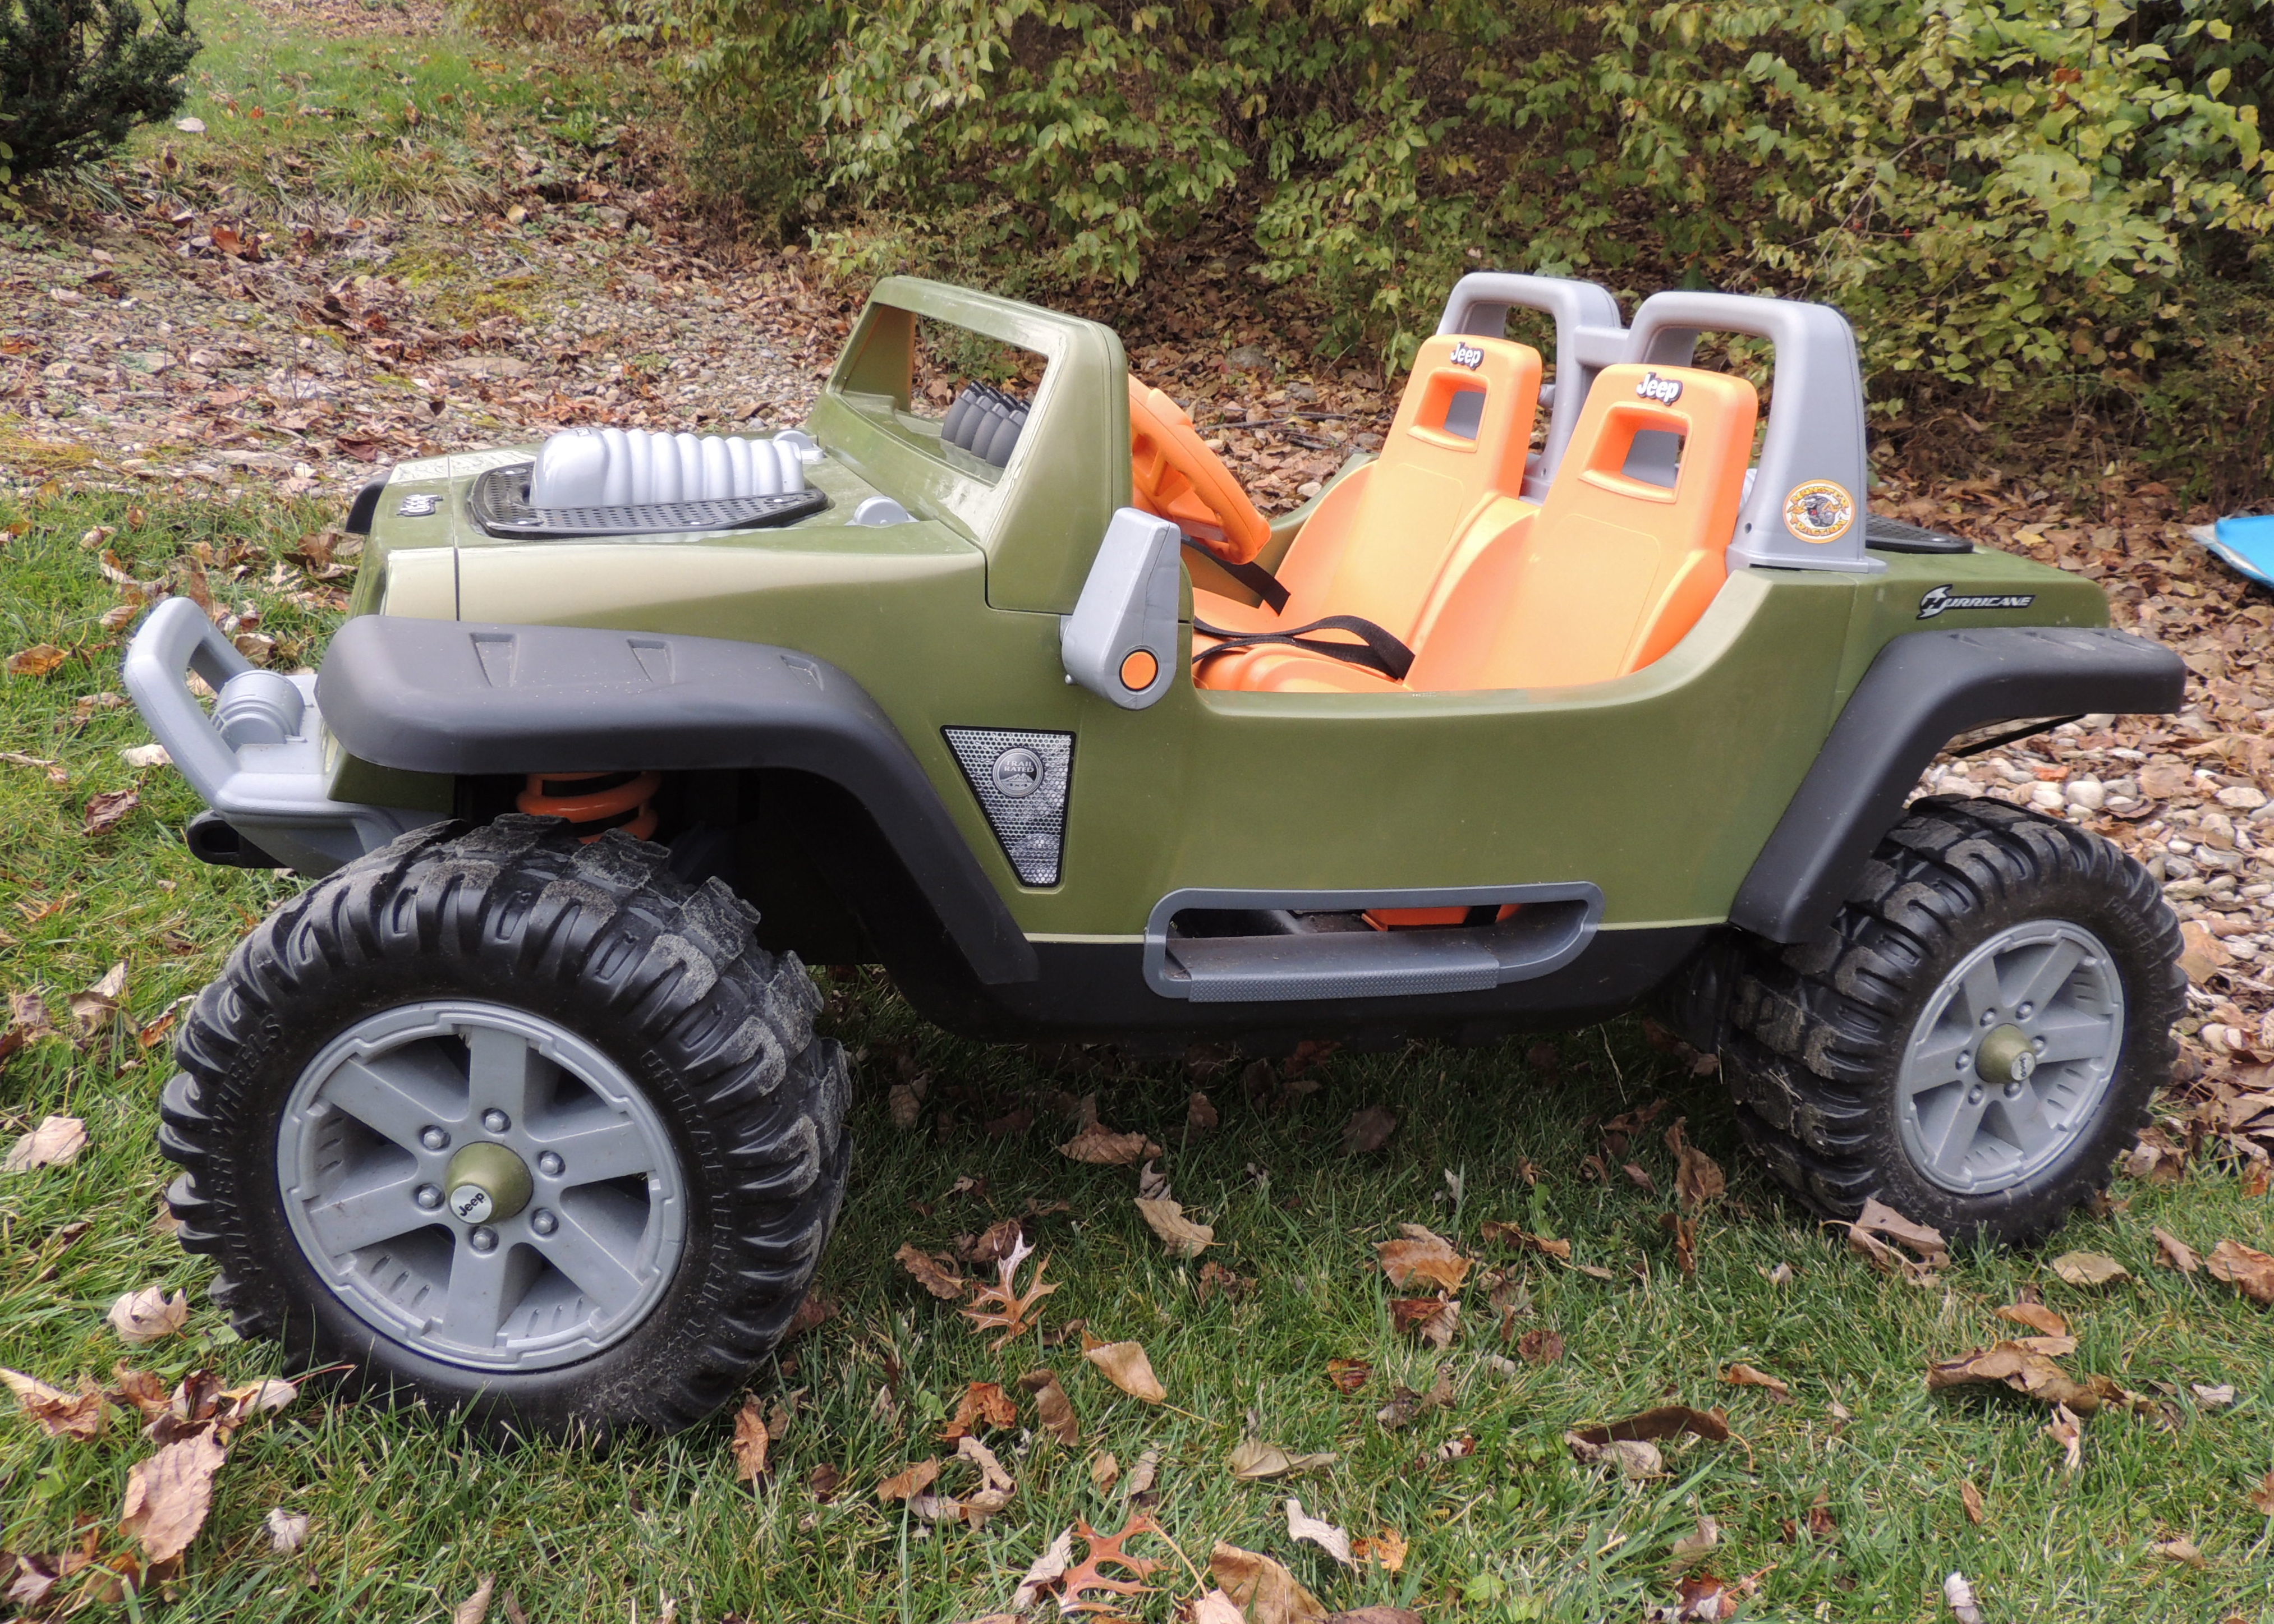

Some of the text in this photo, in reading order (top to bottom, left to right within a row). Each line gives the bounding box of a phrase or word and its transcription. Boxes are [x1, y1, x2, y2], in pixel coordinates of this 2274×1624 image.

[1450, 343, 1482, 368] Jeep
[1636, 373, 1680, 403] Jeep
[1790, 486, 1849, 514] MONSTER
[1917, 585, 2033, 618] HURRICANE
[458, 1192, 485, 1217] Jeep
